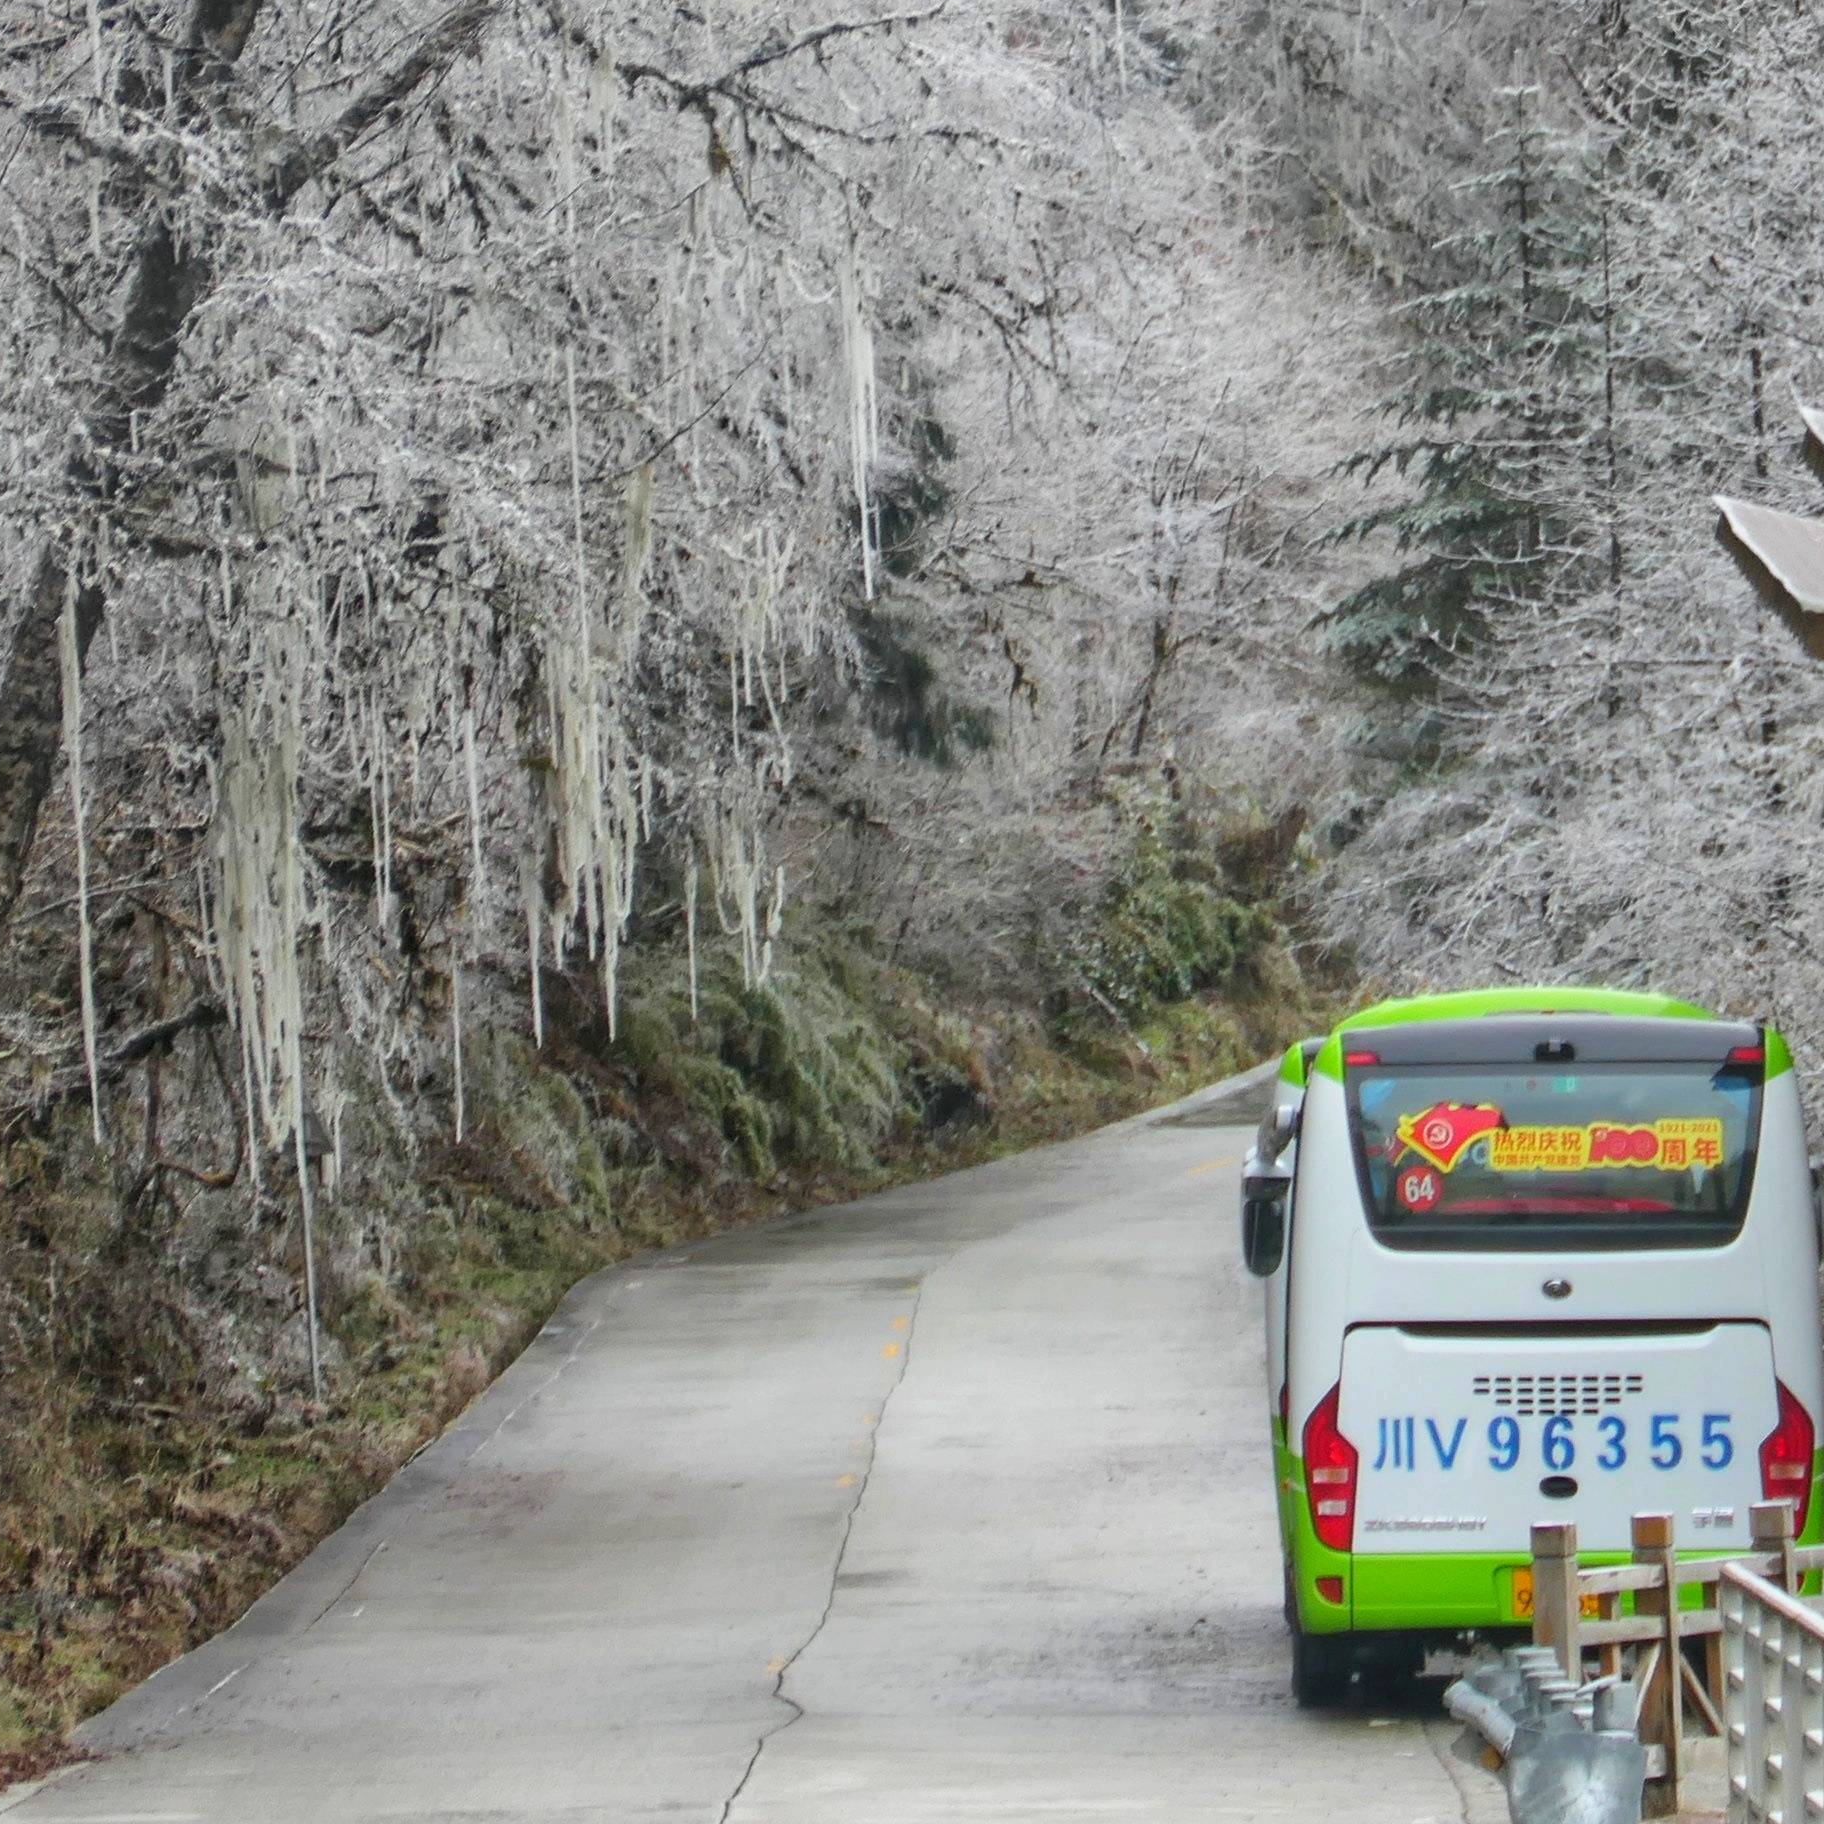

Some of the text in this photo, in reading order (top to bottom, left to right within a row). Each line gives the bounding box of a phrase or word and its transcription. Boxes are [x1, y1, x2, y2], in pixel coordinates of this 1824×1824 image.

[1495, 1130, 1581, 1151] 热烈庆祝
[1589, 1127, 1658, 1162] 100
[1662, 1138, 1719, 1165] 周年
[1405, 1174, 1434, 1203] 64
